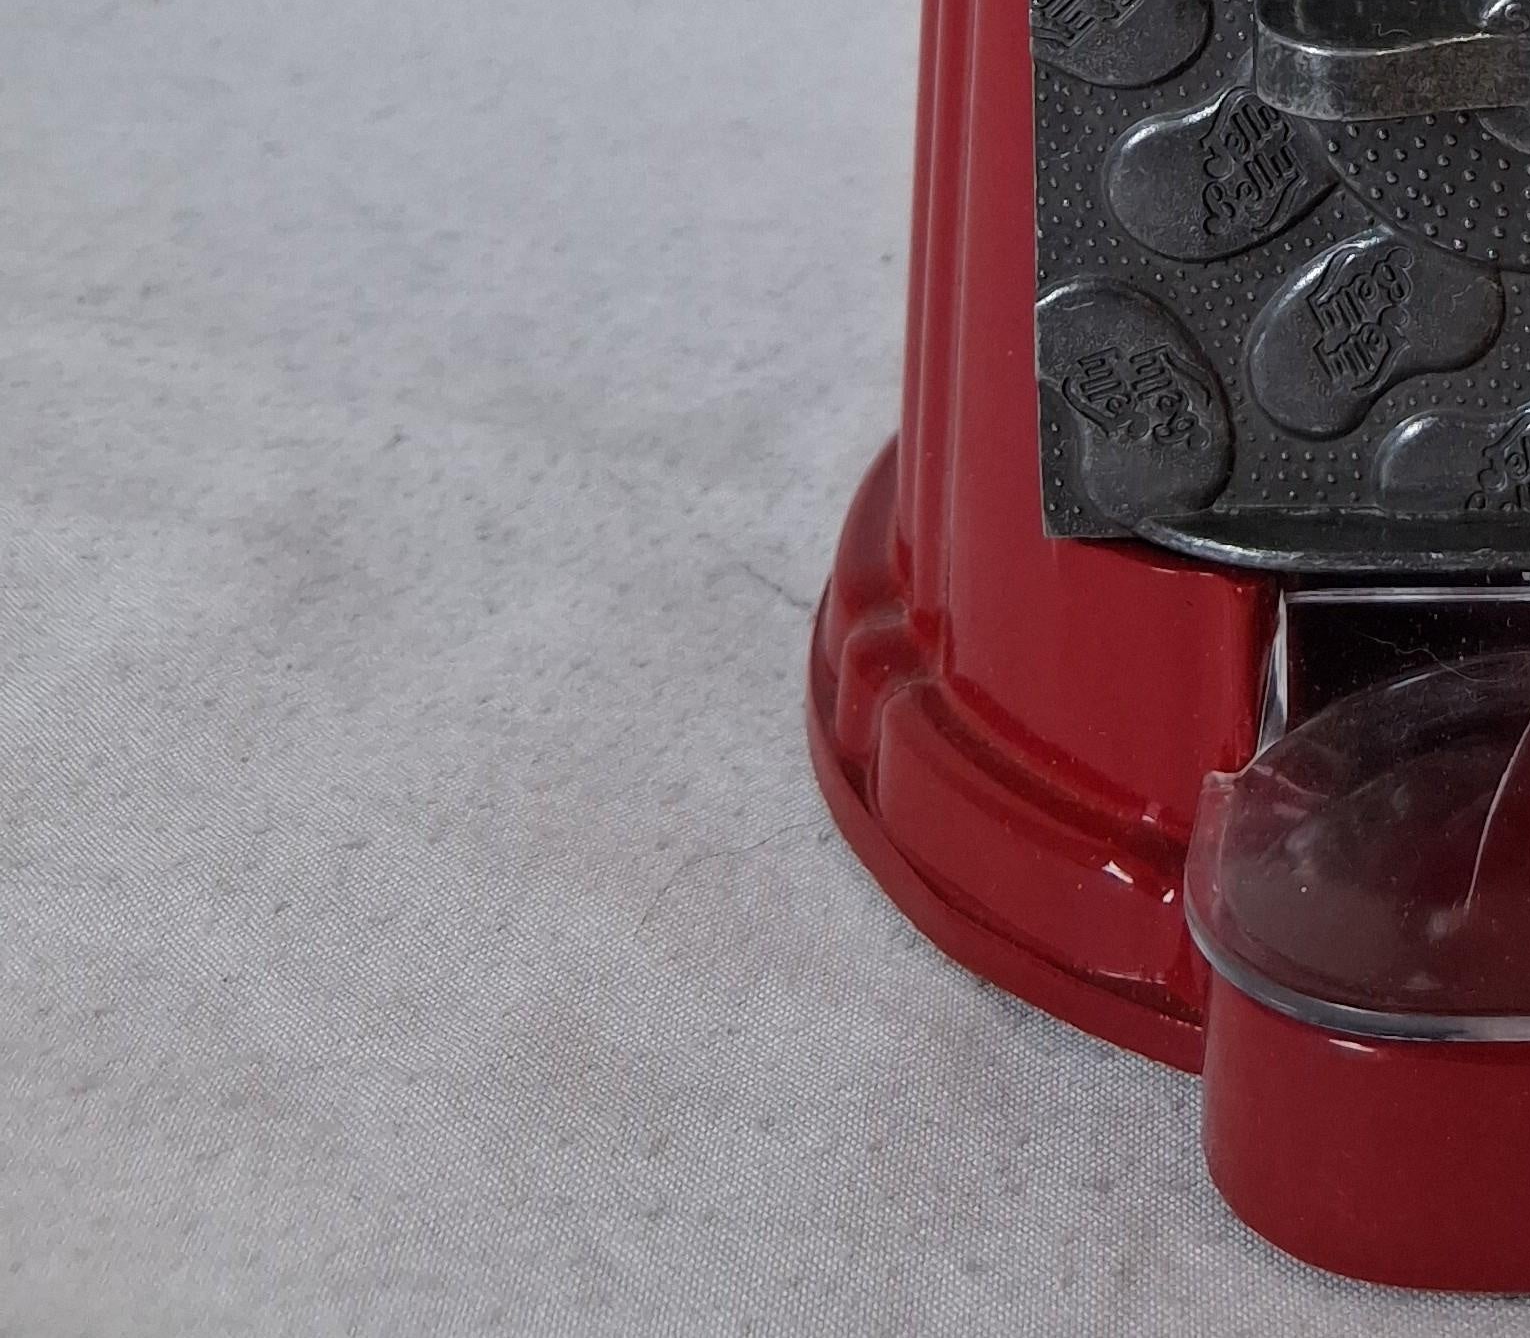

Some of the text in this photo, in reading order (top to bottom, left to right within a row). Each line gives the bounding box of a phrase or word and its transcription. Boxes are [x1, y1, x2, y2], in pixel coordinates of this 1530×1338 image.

[1199, 86, 1297, 182] Jelly
[1202, 144, 1309, 236] Belly
[1305, 245, 1414, 335] Belly
[1312, 303, 1411, 394] Jelly
